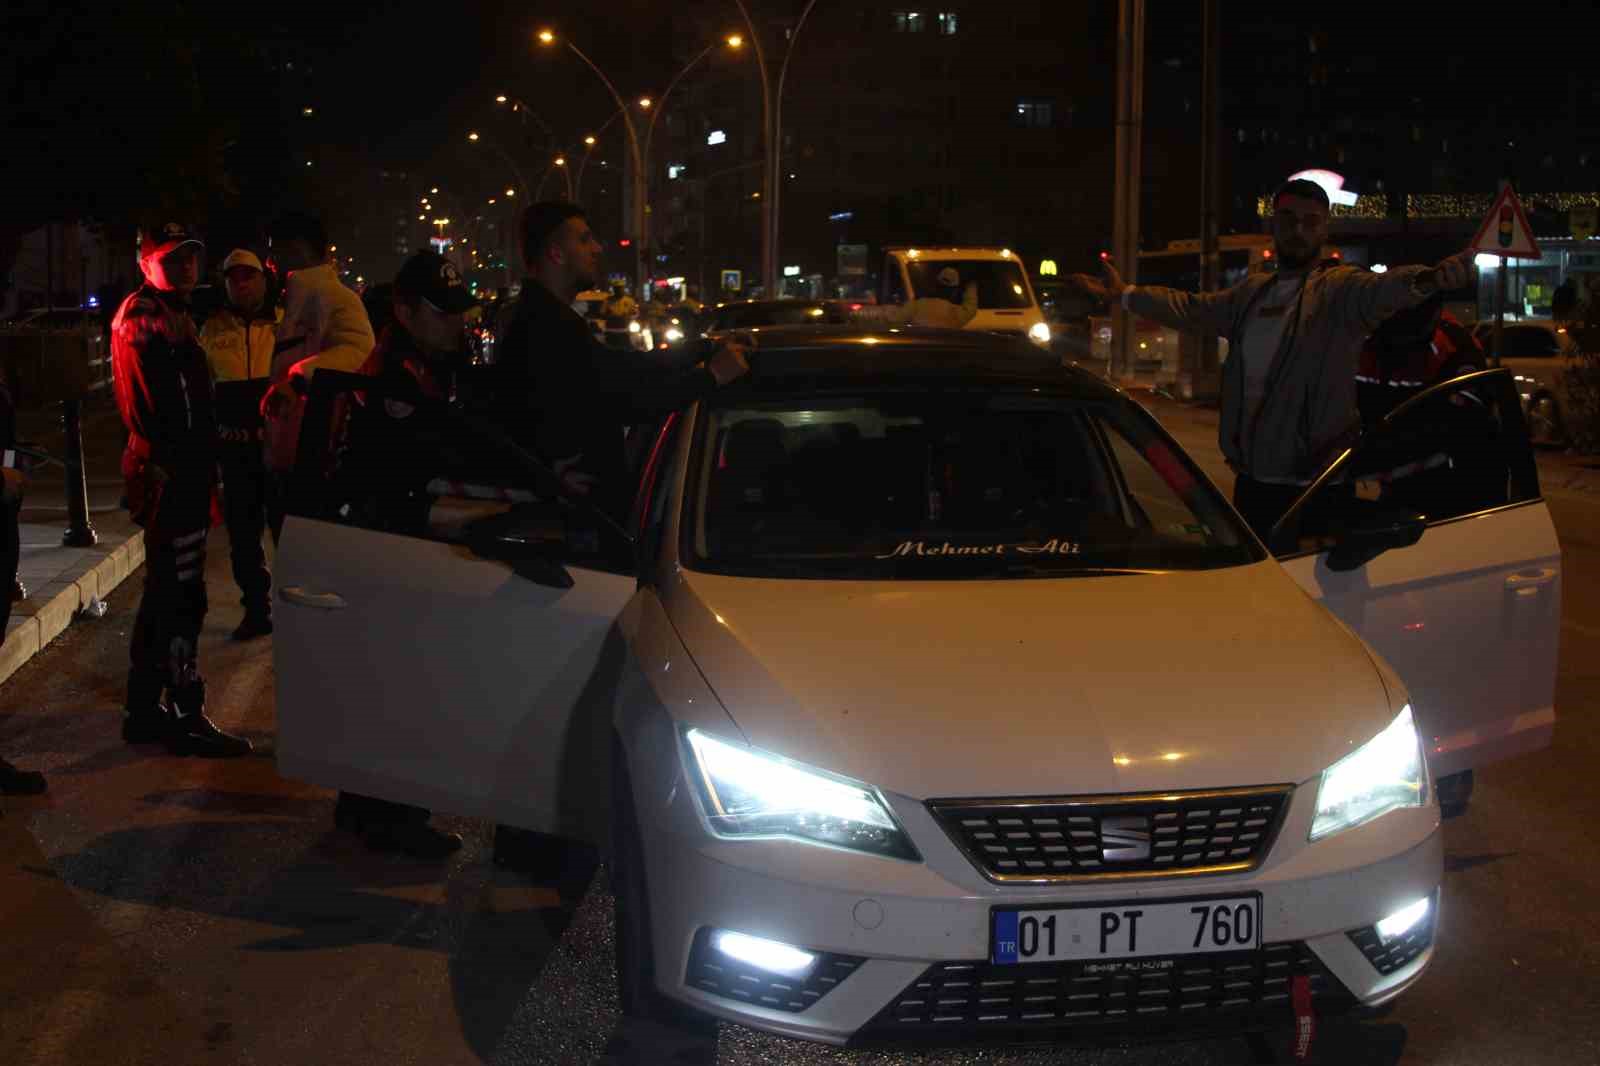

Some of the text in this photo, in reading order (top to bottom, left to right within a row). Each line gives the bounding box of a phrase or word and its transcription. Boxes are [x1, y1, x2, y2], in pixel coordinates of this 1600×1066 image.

[1019, 903, 1253, 957] 01 PT 760
[999, 941, 1016, 953] TR
